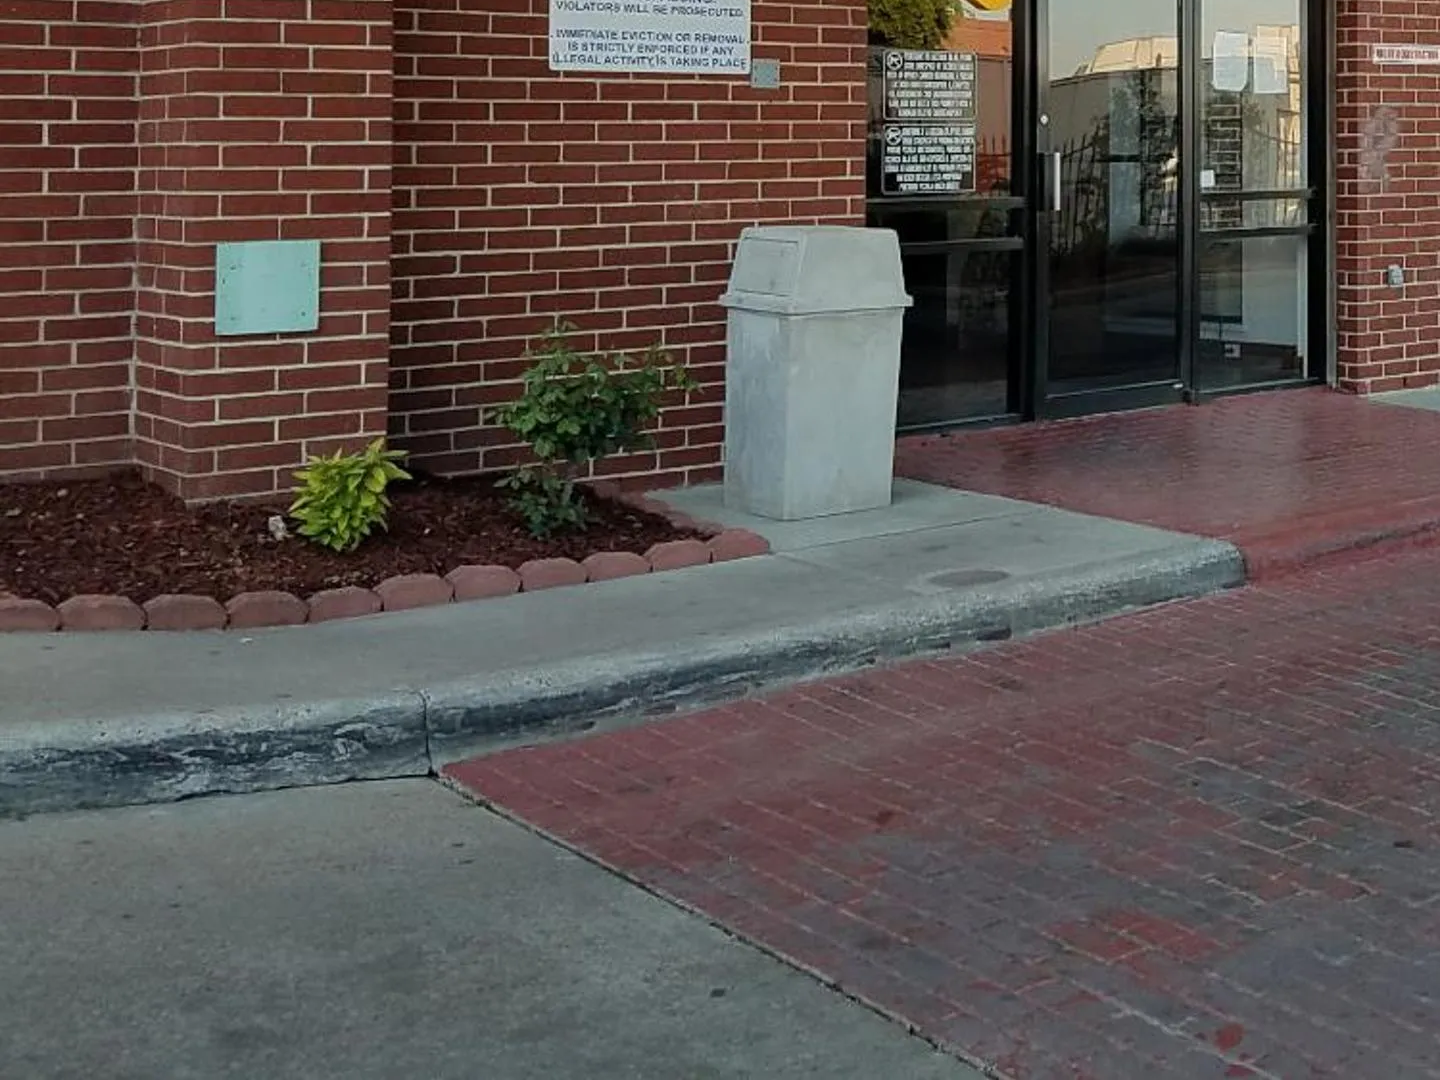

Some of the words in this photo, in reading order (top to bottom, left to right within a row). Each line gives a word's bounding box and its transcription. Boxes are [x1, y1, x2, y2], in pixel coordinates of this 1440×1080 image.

[556, 1, 620, 13] VIOLATORS
[624, 3, 649, 13] WILL
[653, 4, 667, 14] BE
[622, 31, 672, 42] EVICTION
[675, 33, 691, 42] OR
[695, 33, 744, 44] REMOVAL
[568, 41, 578, 51] IS
[581, 42, 634, 53] STRICTLY
[638, 43, 698, 54] ENFORCED
[701, 45, 708, 54] IF
[712, 46, 734, 55] ANY
[553, 52, 601, 64] ILLEGAL
[656, 54, 667, 65] IS
[671, 57, 709, 67] TAKING
[712, 58, 746, 69] PLACE
